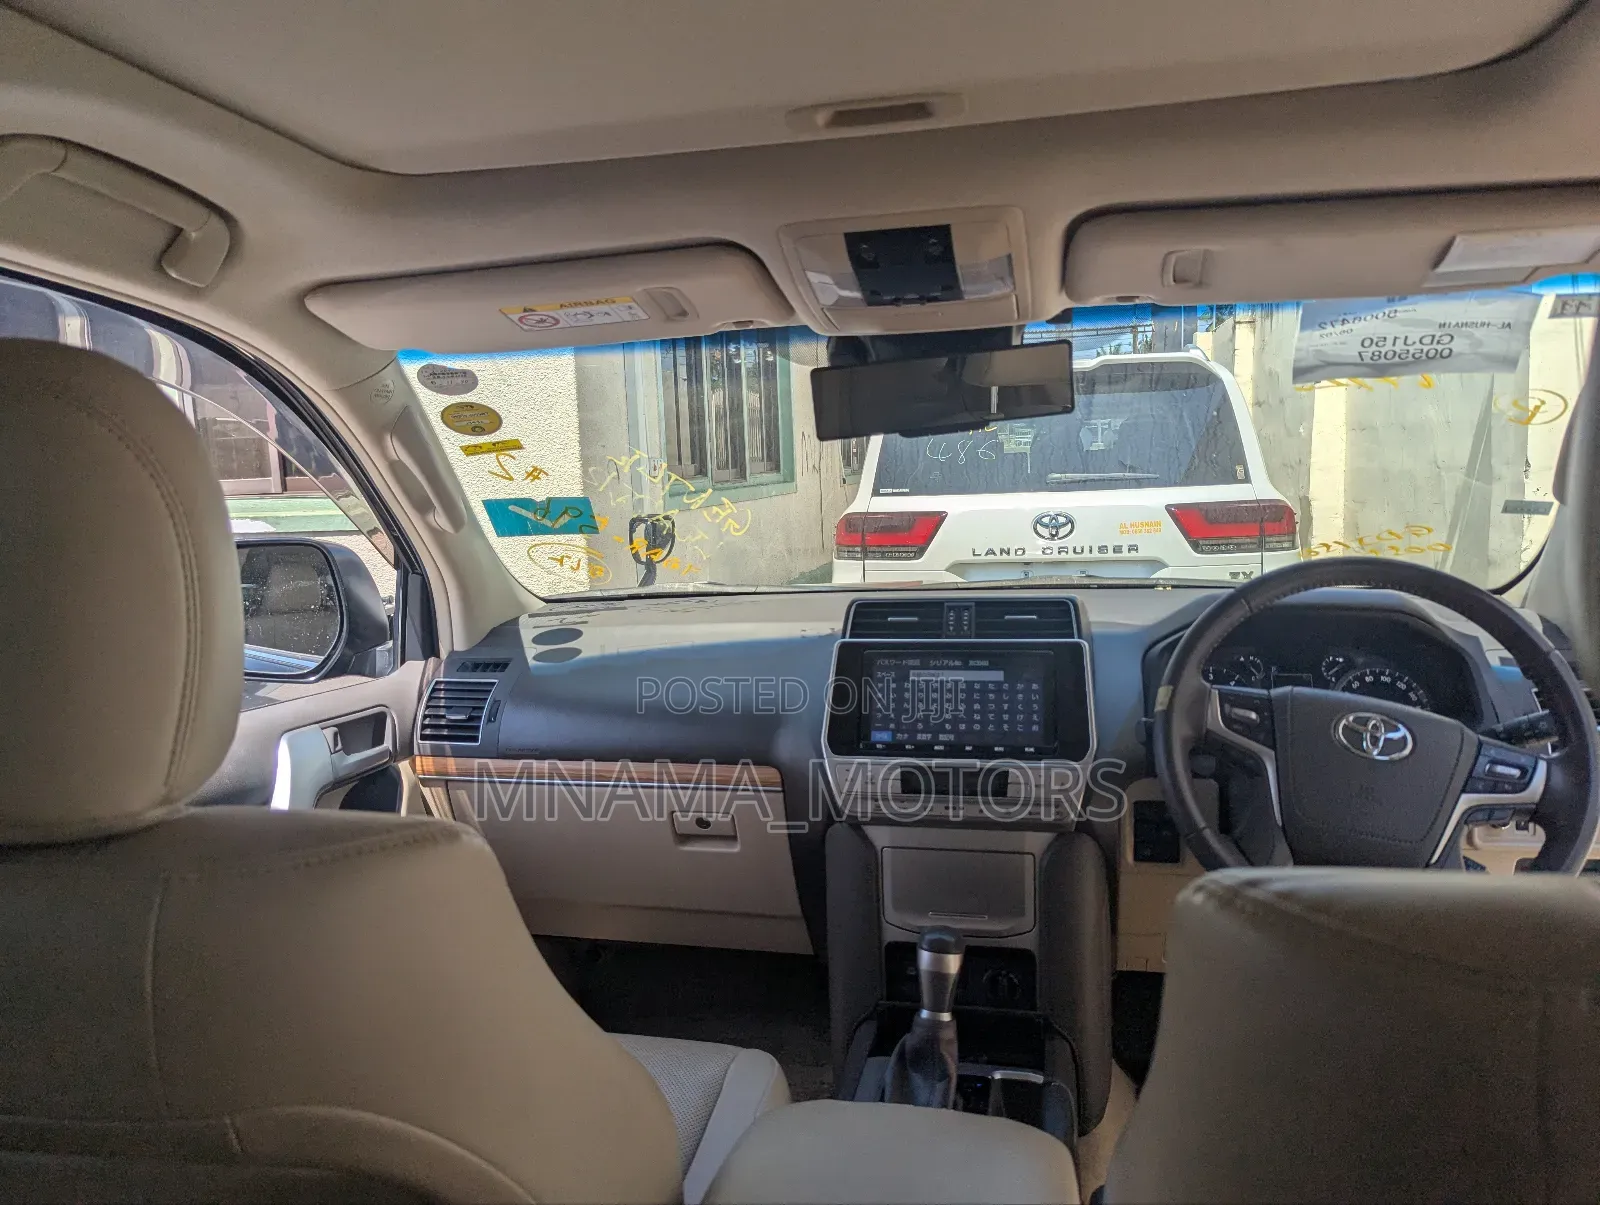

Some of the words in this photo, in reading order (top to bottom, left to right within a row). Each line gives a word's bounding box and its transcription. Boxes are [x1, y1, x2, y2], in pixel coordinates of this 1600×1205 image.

[971, 546, 1027, 558] LAND
[1041, 544, 1140, 558] CRUISER
[1380, 675, 1392, 684] 100
